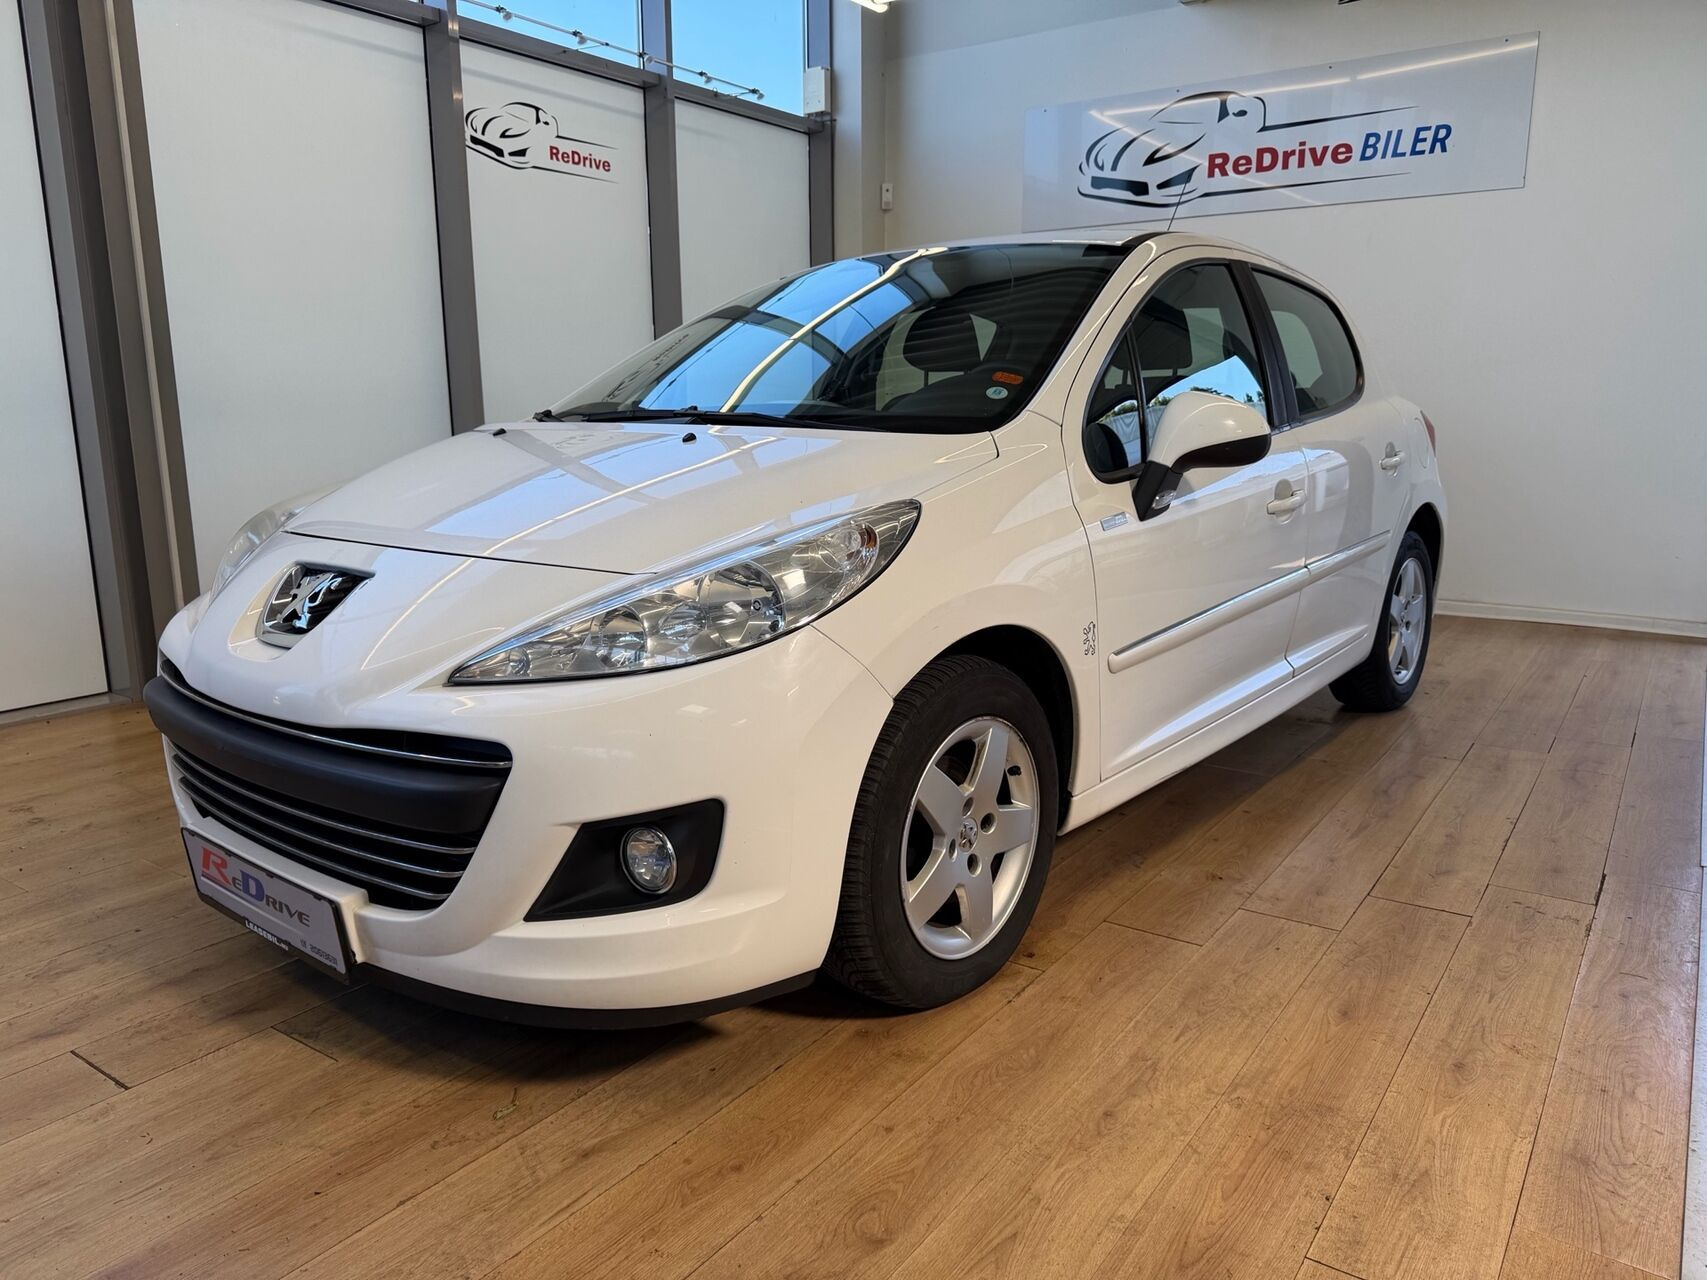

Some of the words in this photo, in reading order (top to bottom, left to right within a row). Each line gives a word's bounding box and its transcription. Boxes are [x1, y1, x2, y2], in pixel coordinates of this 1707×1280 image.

[549, 146, 611, 171] ReDrive
[1207, 141, 1353, 178] ReDrive
[1359, 124, 1452, 161] BILER
